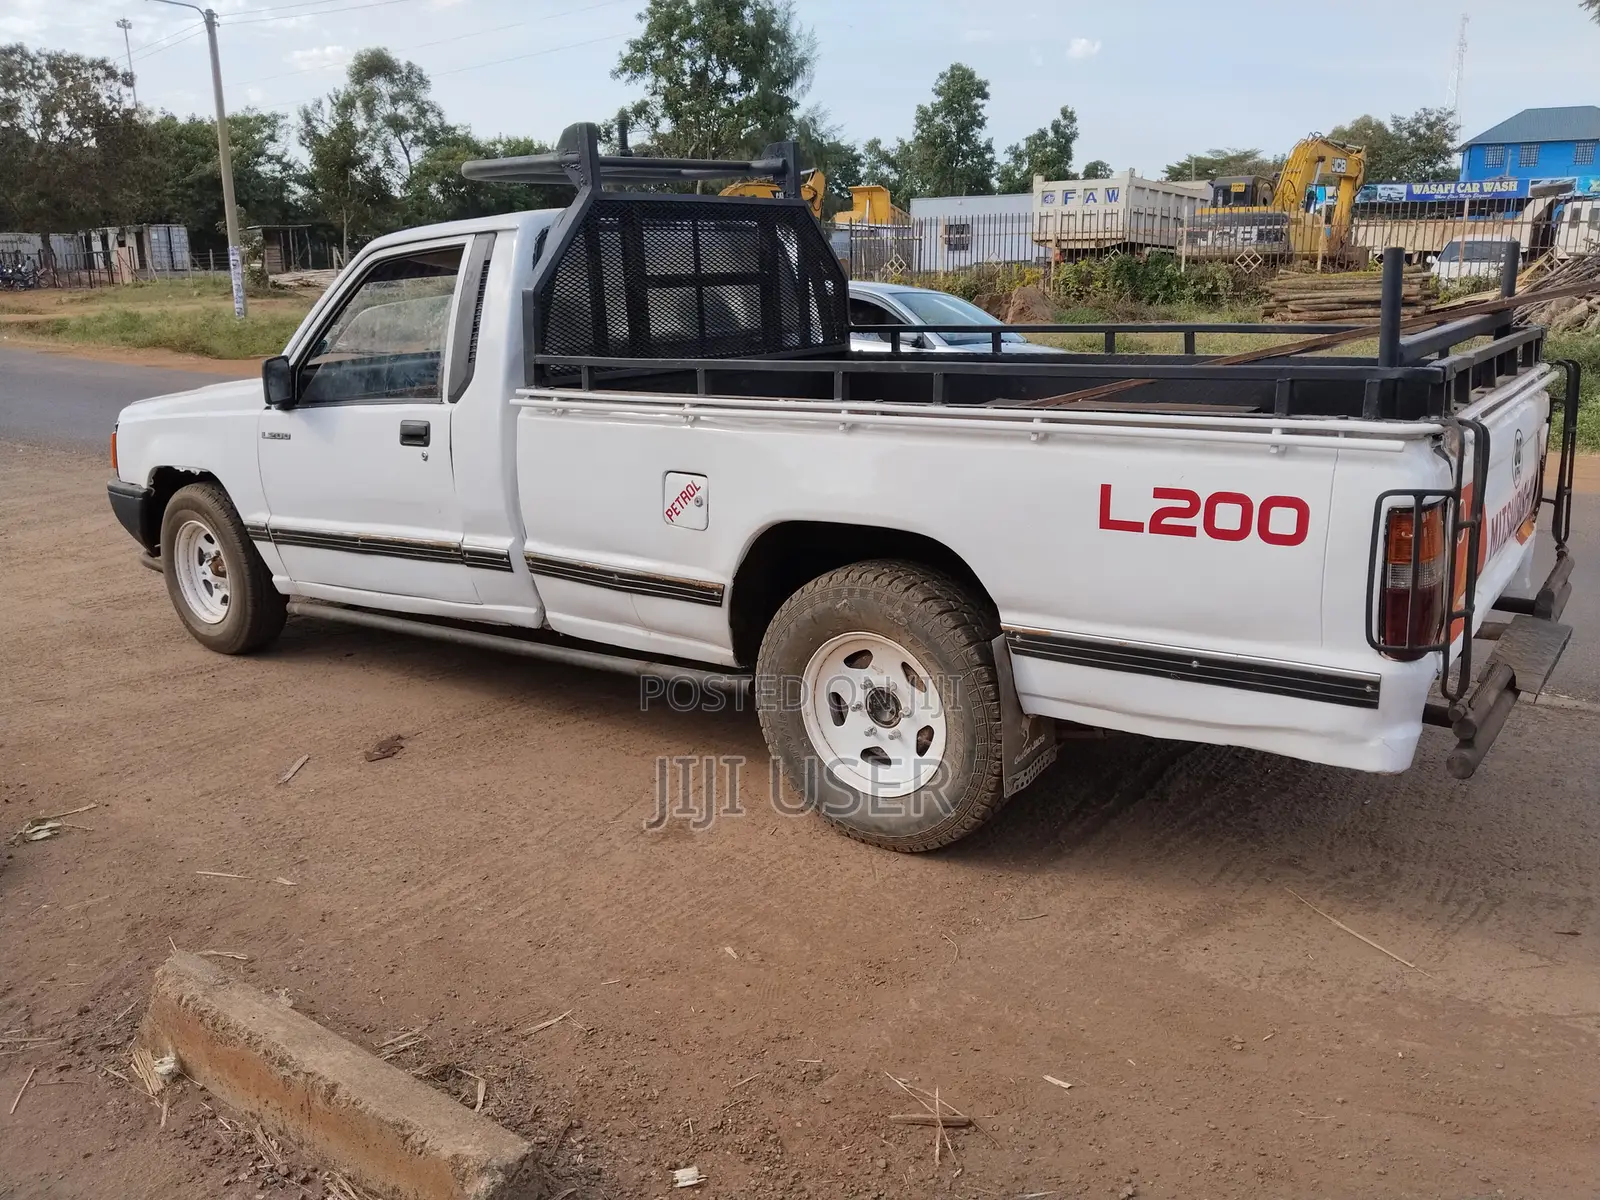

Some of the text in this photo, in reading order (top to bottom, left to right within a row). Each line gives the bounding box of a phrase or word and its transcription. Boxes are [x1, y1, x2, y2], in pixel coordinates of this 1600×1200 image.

[1331, 157, 1347, 173] JCB
[1412, 181, 1518, 195] WASAFI CAR WASH
[1064, 189, 1120, 205] FAW
[665, 480, 701, 523] PETROL
[1099, 483, 1310, 547] L200
